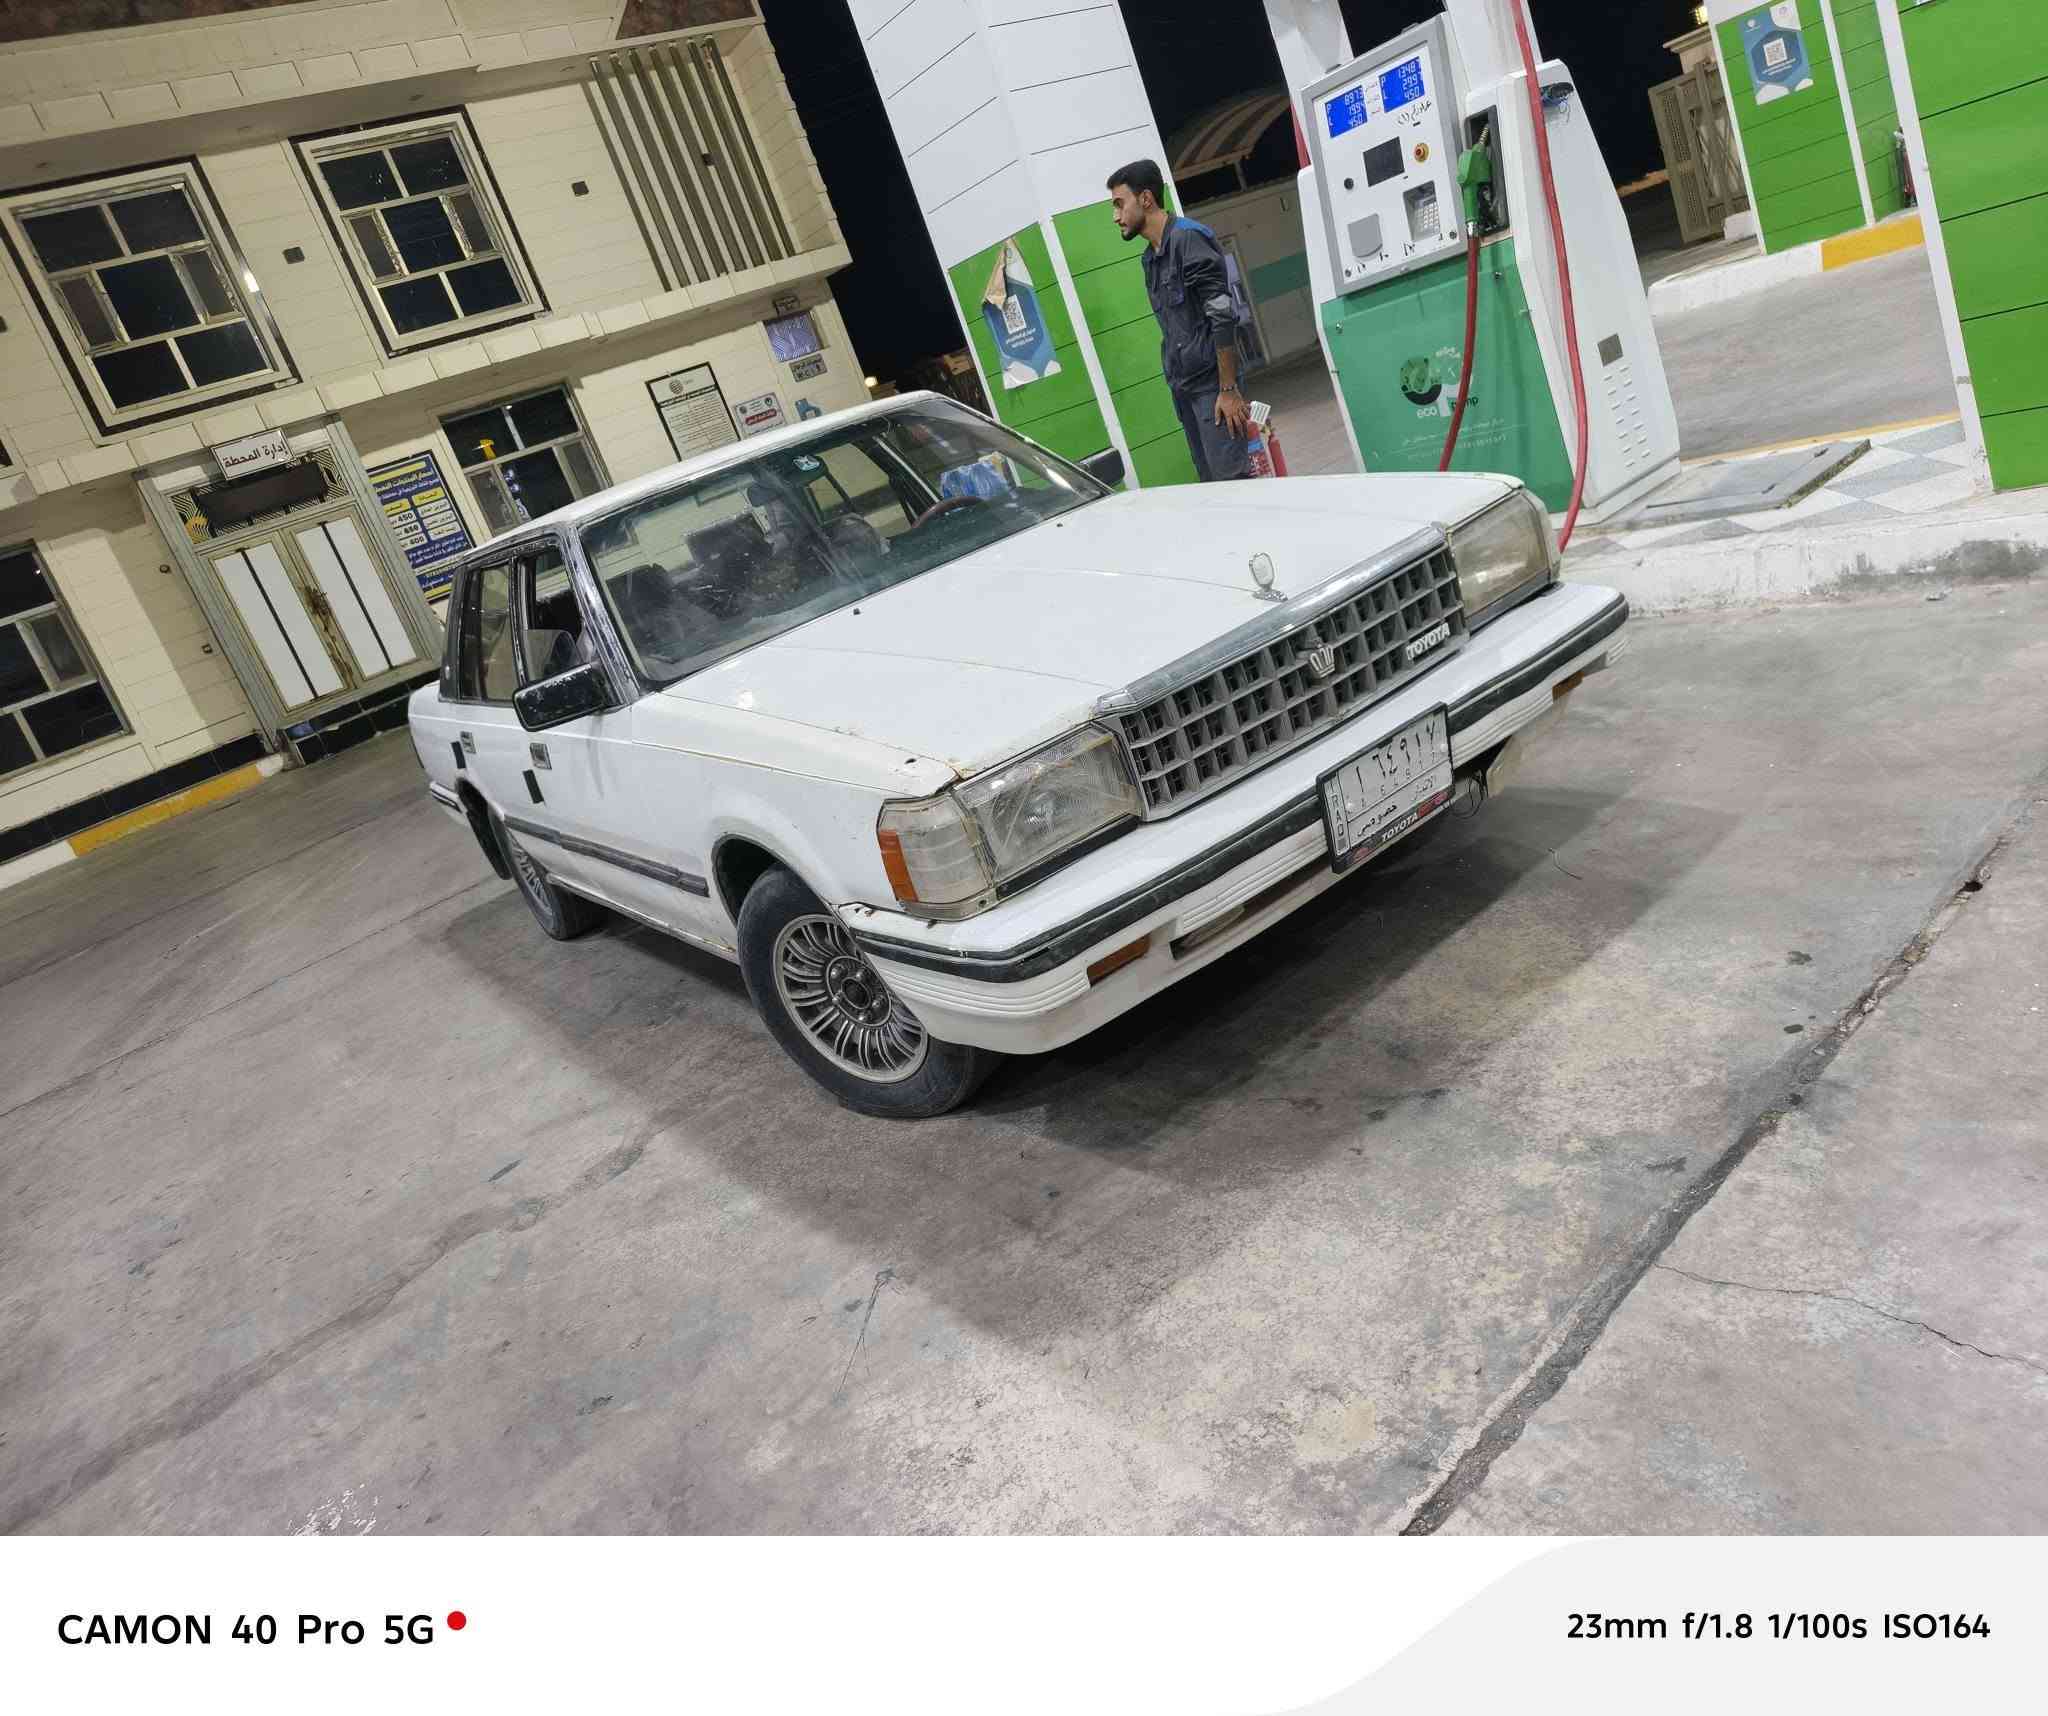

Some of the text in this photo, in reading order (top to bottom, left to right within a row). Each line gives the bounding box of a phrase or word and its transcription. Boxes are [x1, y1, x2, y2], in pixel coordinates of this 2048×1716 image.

[1416, 396, 1479, 419] eco pmp
[223, 438, 289, 468] إدارة المحطة
[397, 512, 413, 522] 450
[1406, 622, 1450, 661] TOYOTA
[1382, 812, 1418, 842] TOYOTA
